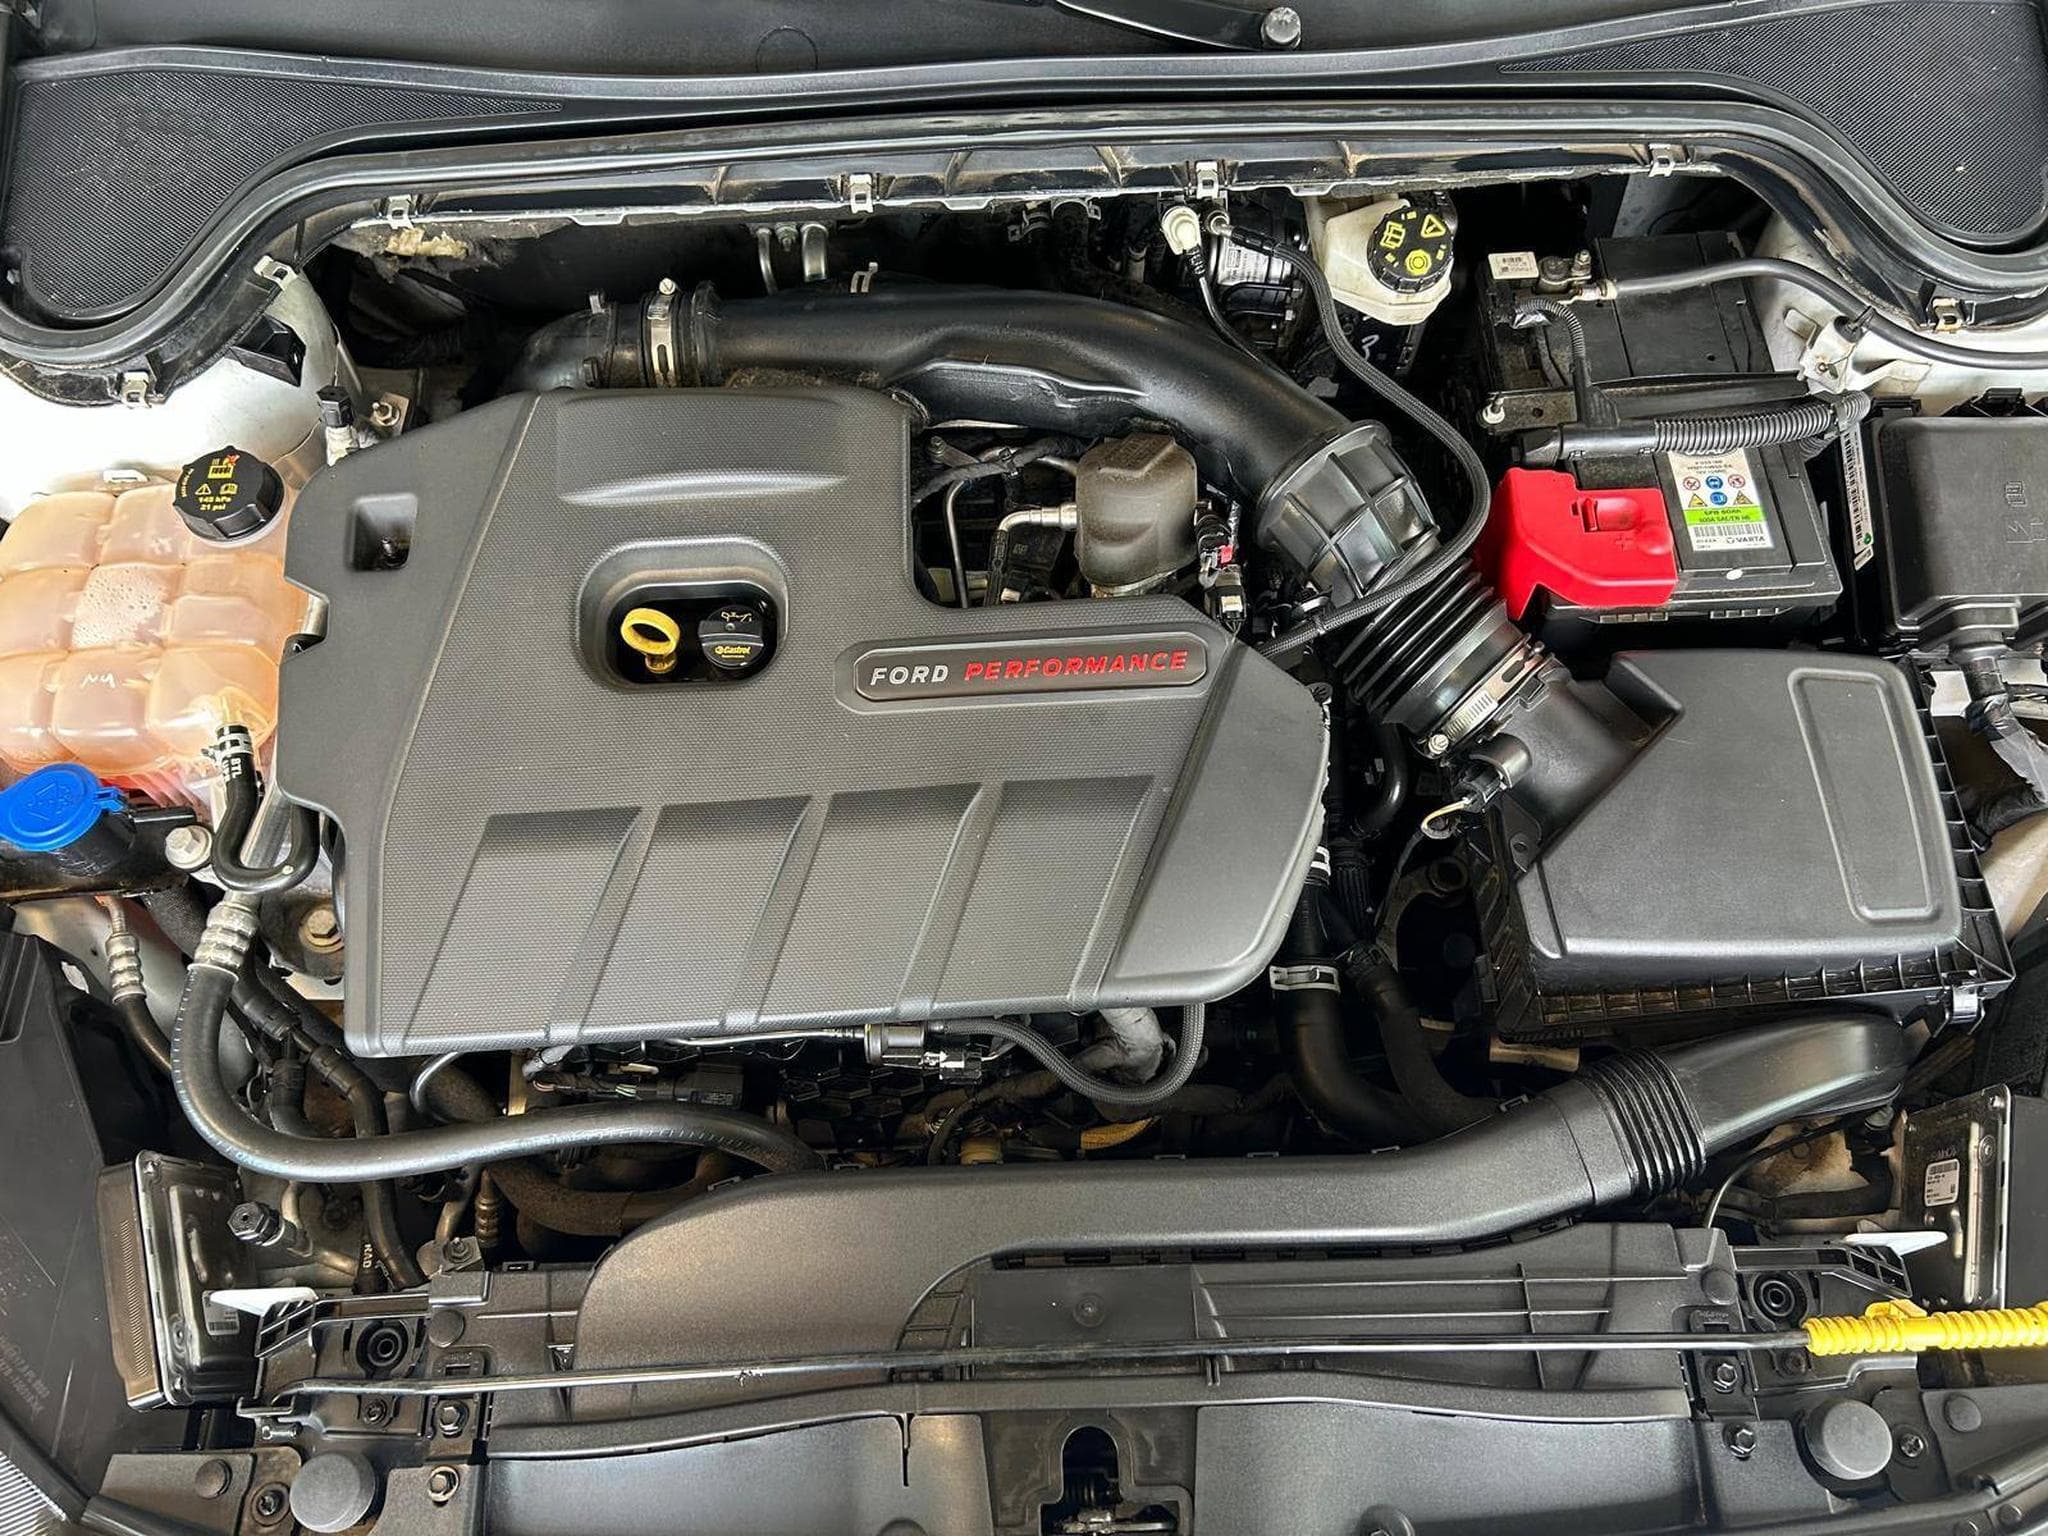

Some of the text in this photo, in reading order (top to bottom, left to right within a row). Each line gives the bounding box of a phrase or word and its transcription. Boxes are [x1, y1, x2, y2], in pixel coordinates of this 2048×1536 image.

[724, 645, 751, 655] Castrol
[870, 650, 1189, 687] FORD PERFORMANCE
